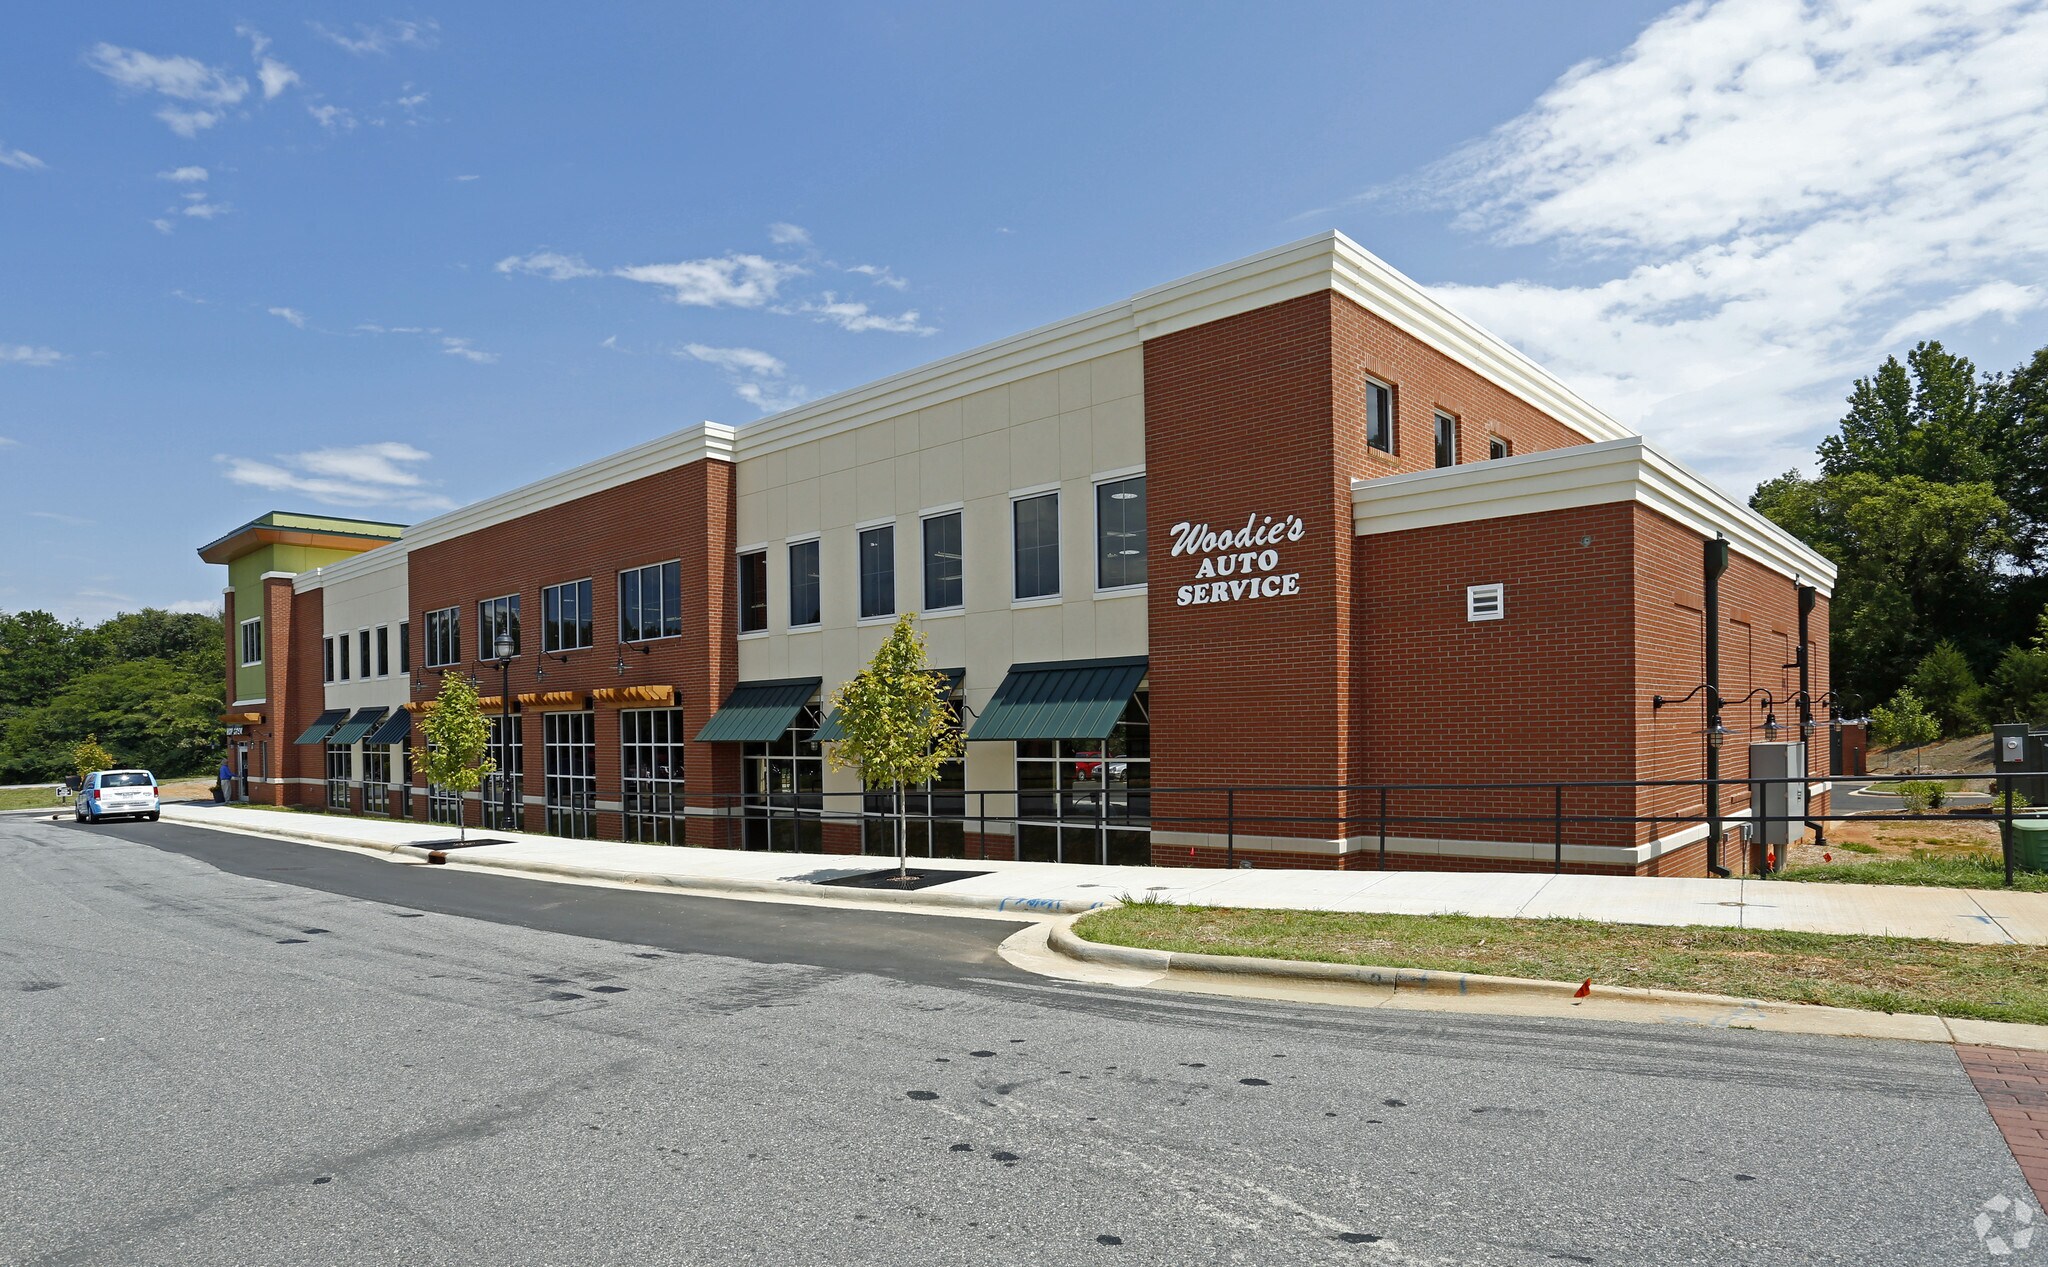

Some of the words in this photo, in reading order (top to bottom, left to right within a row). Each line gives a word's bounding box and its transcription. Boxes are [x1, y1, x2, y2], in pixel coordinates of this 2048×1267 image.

[1169, 512, 1306, 557] Woodie's
[1195, 549, 1279, 579] AUTO
[1176, 572, 1300, 606] SERVICE
